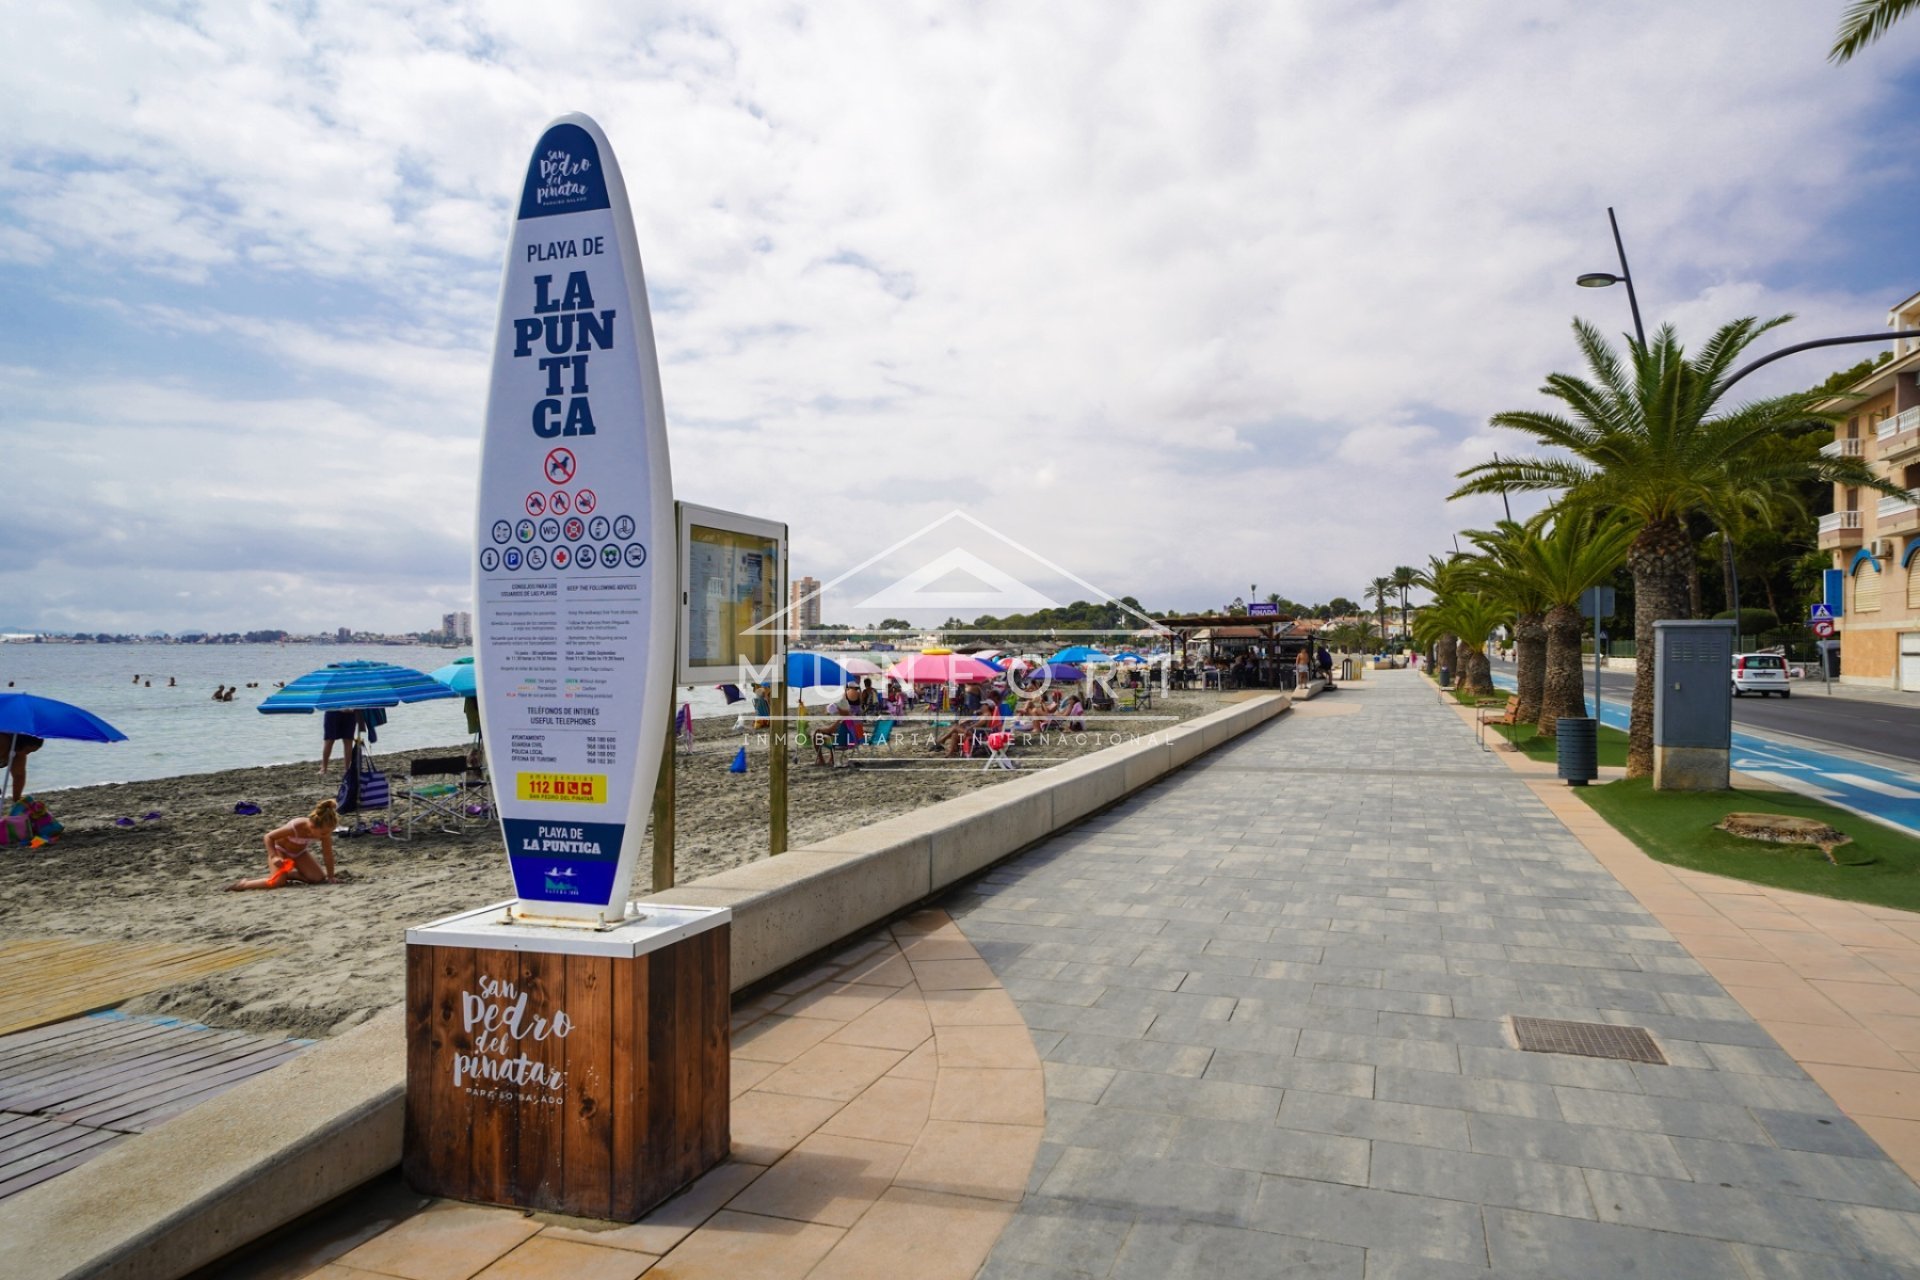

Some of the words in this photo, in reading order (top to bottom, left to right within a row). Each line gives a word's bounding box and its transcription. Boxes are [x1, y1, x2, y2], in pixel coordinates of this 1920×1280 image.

[547, 150, 566, 161] san
[527, 240, 577, 263] PLAYA
[583, 236, 604, 256] DE
[534, 270, 595, 314] LA
[513, 309, 616, 358] PUN
[538, 354, 589, 396] TI
[532, 396, 596, 439] CA
[543, 526, 557, 535] WC
[527, 706, 562, 715] TELÉFONOS
[573, 707, 600, 716] INTERÉS
[556, 718, 596, 726] TELEPHONES
[529, 781, 550, 794] 112
[538, 826, 567, 838] PLAYA
[570, 828, 583, 840] DE
[523, 839, 540, 851] LA
[542, 840, 602, 855] PUNTICA
[479, 975, 518, 999] san
[462, 990, 576, 1041] Pedro
[475, 1030, 509, 1055] del
[453, 1052, 564, 1090] pinatar
